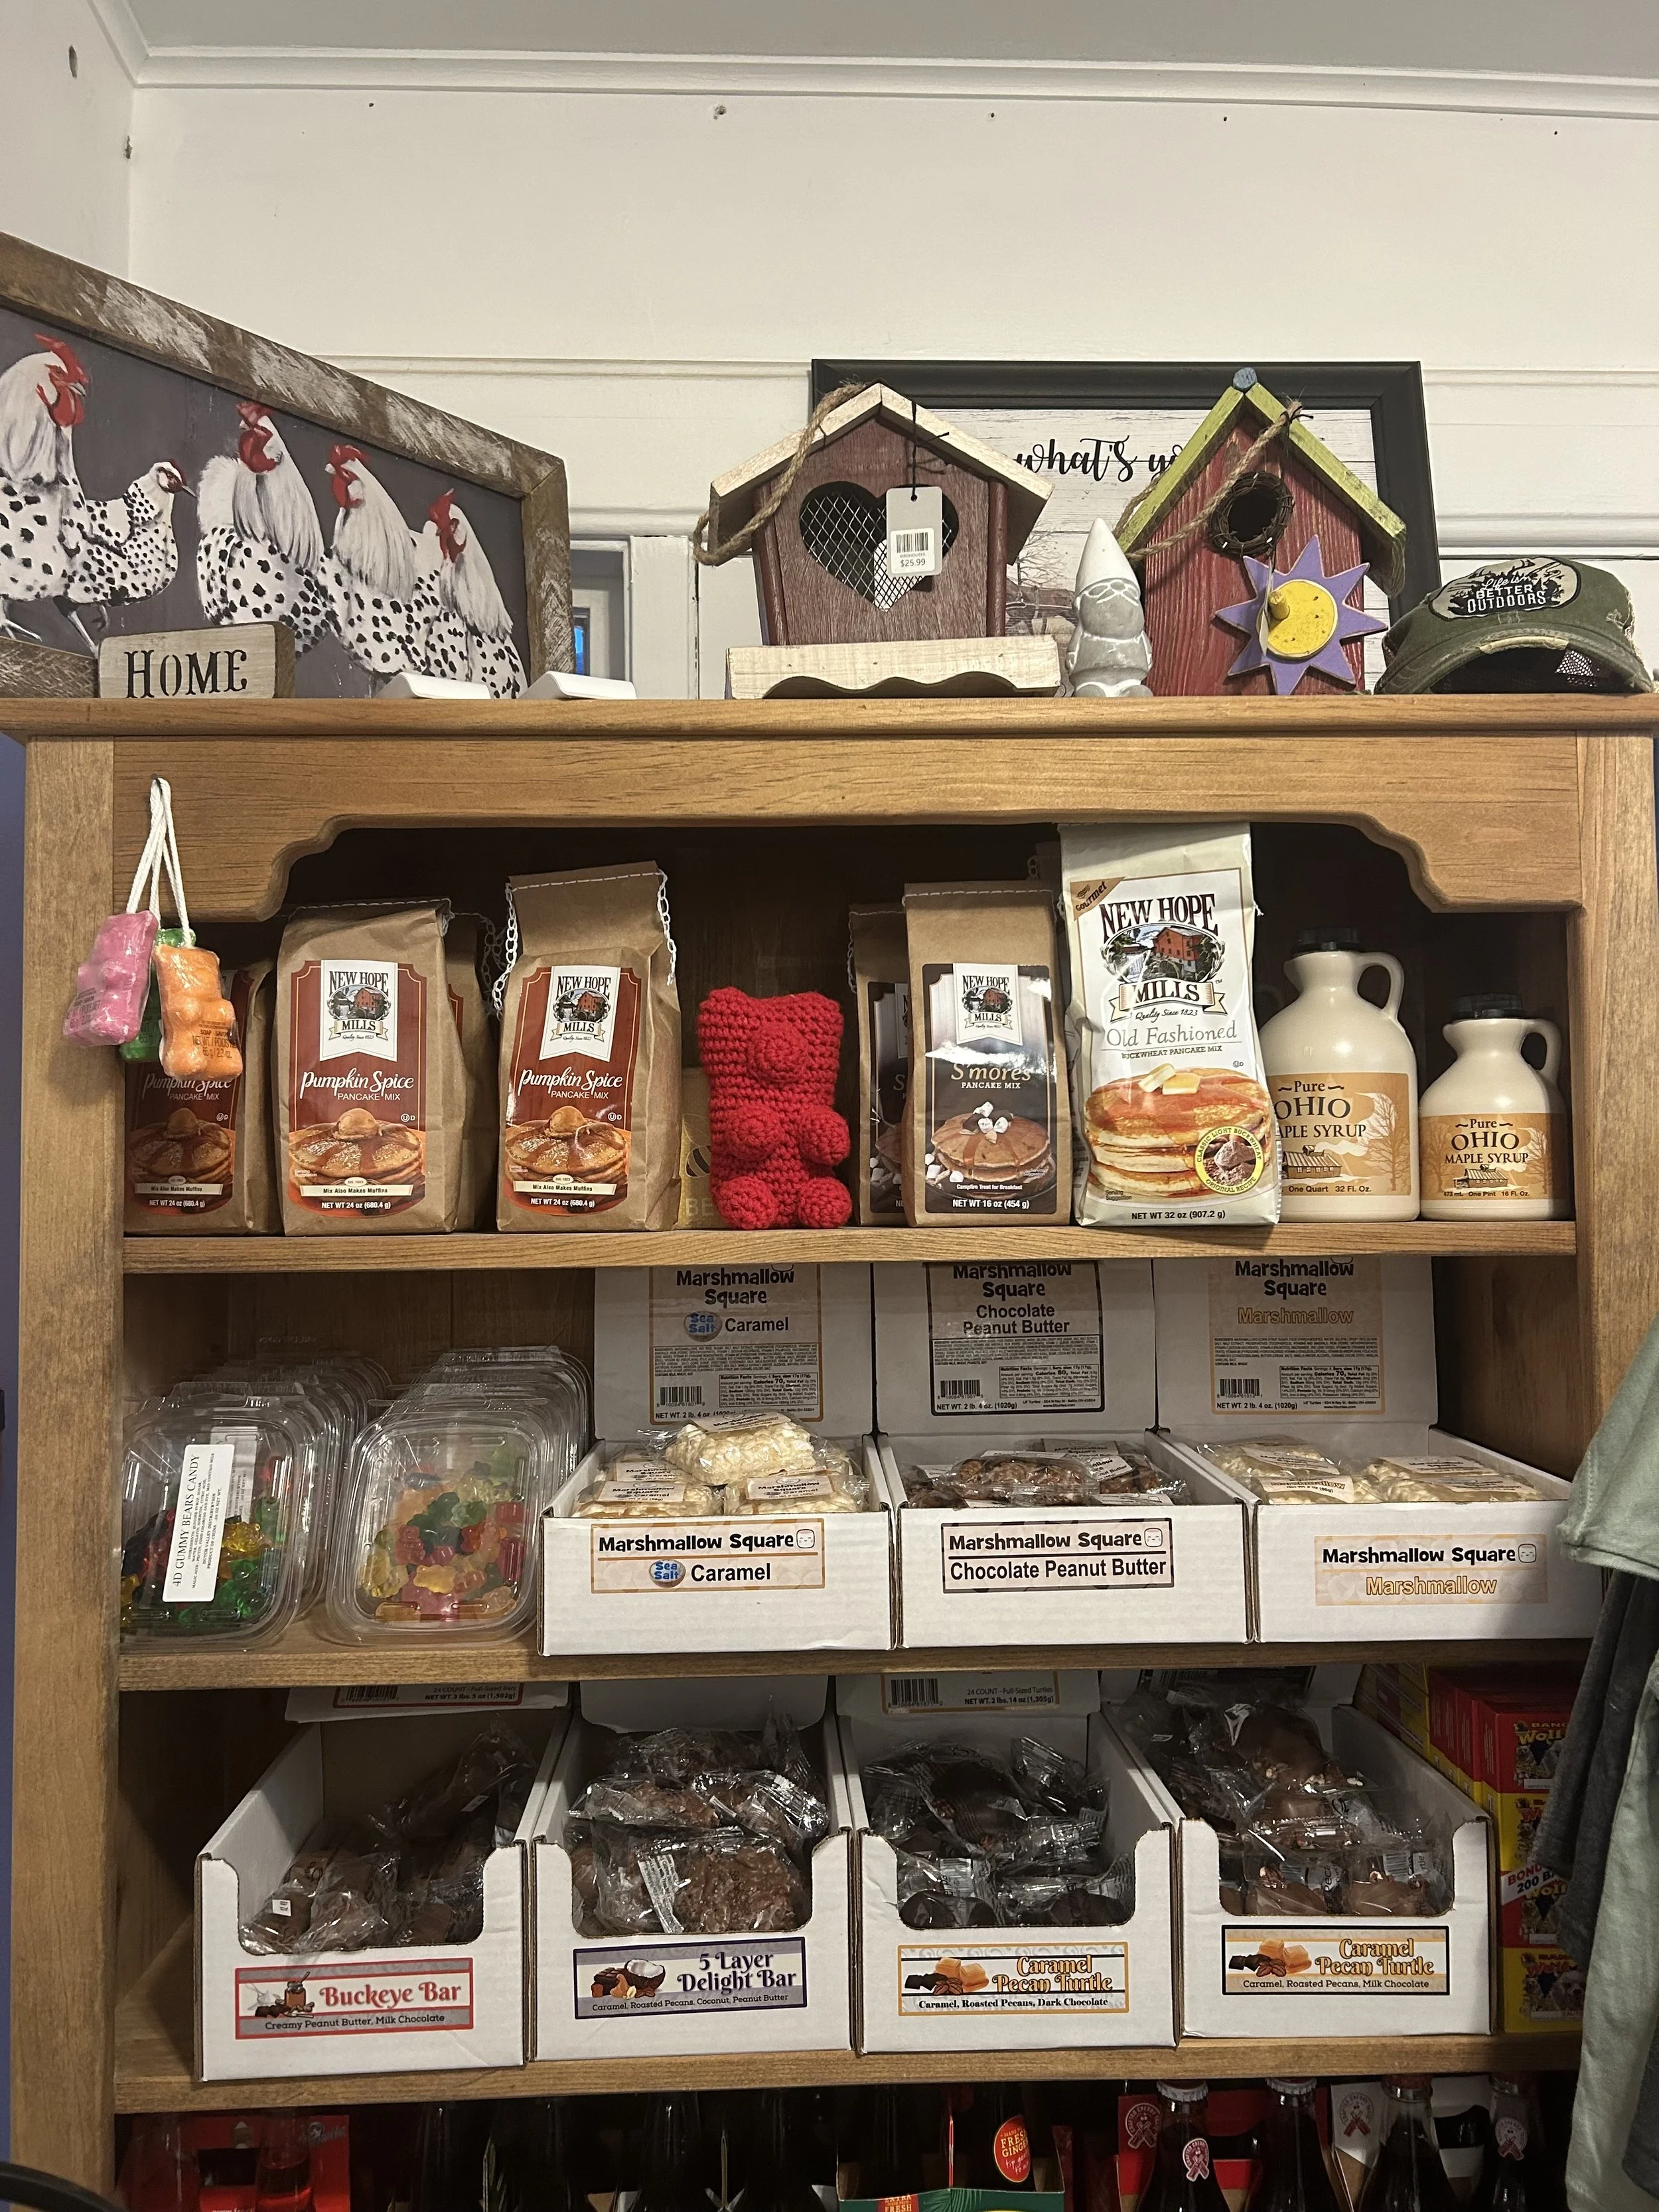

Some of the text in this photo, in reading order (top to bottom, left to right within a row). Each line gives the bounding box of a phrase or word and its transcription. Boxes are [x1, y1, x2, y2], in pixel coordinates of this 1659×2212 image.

[1017, 435, 1138, 482] what's
[901, 558, 926, 567] $25.99
[1477, 584, 1533, 599] BETTER
[1480, 577, 1510, 591] Life
[1467, 590, 1546, 613] OUTDOORS
[124, 649, 248, 699] HOME
[1075, 881, 1108, 912] Gourmet
[1099, 893, 1218, 943] NEW HOPE
[329, 971, 389, 997] NEW HOPE
[557, 976, 611, 999] NEW HOPE
[962, 975, 1009, 995] NEW HOPE
[1132, 980, 1200, 1003] MILLS
[342, 1019, 376, 1031] MILLS
[975, 1013, 1002, 1021] MILLS
[1135, 1008, 1160, 1023] Quality
[563, 1022, 595, 1033] MILLS
[1106, 1020, 1237, 1047] Old Fashioned
[1121, 1049, 1167, 1059] BUCKWHEAT
[1169, 1047, 1206, 1055] PANCAKE
[518, 1067, 622, 1096] Pumpkin Spice
[950, 1063, 1031, 1081] S'mores
[300, 1067, 414, 1099] Pumpkin Spice
[1294, 1080, 1325, 1092] Pure
[338, 1092, 380, 1101] PANCAKE
[1273, 1096, 1351, 1120] OHIO
[1279, 1124, 1366, 1138] APLE SYRUP
[1470, 1119, 1497, 1128] Pure
[1196, 1128, 1262, 1163] CLASSIC LIGHT BUCKWHEAT
[1451, 1132, 1519, 1150] OHIO
[1445, 1153, 1529, 1164] MAPLE SYRUP
[1205, 1177, 1256, 1193] ORIGINAL RECIPE
[1004, 1199, 1020, 1209] (454
[1022, 1199, 1029, 1209] g)
[1189, 1211, 1214, 1220] (907.2
[1217, 1210, 1226, 1220] g)
[676, 1268, 794, 1286] Marshmallow
[953, 1264, 1071, 1280] Marshmallow
[1235, 1259, 1354, 1278] Marshmallow
[705, 1289, 767, 1309] Square
[982, 1282, 1046, 1301] Square
[1264, 1280, 1327, 1299] Square
[690, 1312, 714, 1323] Sea
[976, 1303, 1055, 1319] Chocolate
[1238, 1307, 1354, 1324] Marshmallow
[688, 1317, 789, 1333] Salt Caramel
[963, 1319, 1070, 1335] Peanut Butter
[173, 1455, 200, 1587] 4D GUMMY BEARS CANDY
[599, 1533, 794, 1552] Marshmallow Square
[949, 1532, 1142, 1550] Marshmallow Square
[1323, 1546, 1516, 1565] Marshmallow Square
[654, 1563, 771, 1582] Salt Caramel
[655, 1561, 678, 1571] Sea
[950, 1558, 1167, 1580] Chocolate Peanut Butter
[1366, 1576, 1497, 1595] Marshmallow
[1517, 1876, 1540, 1894] 200
[1339, 1938, 1415, 1959] Caramel
[699, 1951, 774, 1974] 5 Layer
[1016, 1954, 1092, 1977] Caramel
[1315, 1956, 1435, 1976] Pecan Turtle
[677, 1969, 796, 1995] Delight Bar
[992, 1972, 1114, 1993] Pecan Turtle
[1243, 1980, 1284, 1989] Caramel,
[1287, 1980, 1323, 1988] Roasted
[1326, 1980, 1361, 1989] Pecans,
[1363, 1980, 1382, 1988] Milk
[320, 1982, 462, 2008] Buckeye Bar
[593, 1993, 789, 2012] Caramel, Roasted Pecans, Coconut, Peanut Butter
[918, 1998, 1109, 2009] Caramel, Roasted Pecans, Dark Chocolate
[265, 2021, 303, 2031] Creamy
[305, 2020, 338, 2029] Peanut
[376, 2016, 396, 2024] Milk
[399, 2014, 445, 2024] Chocolate
[1002, 2138, 1028, 2158] GINGE
